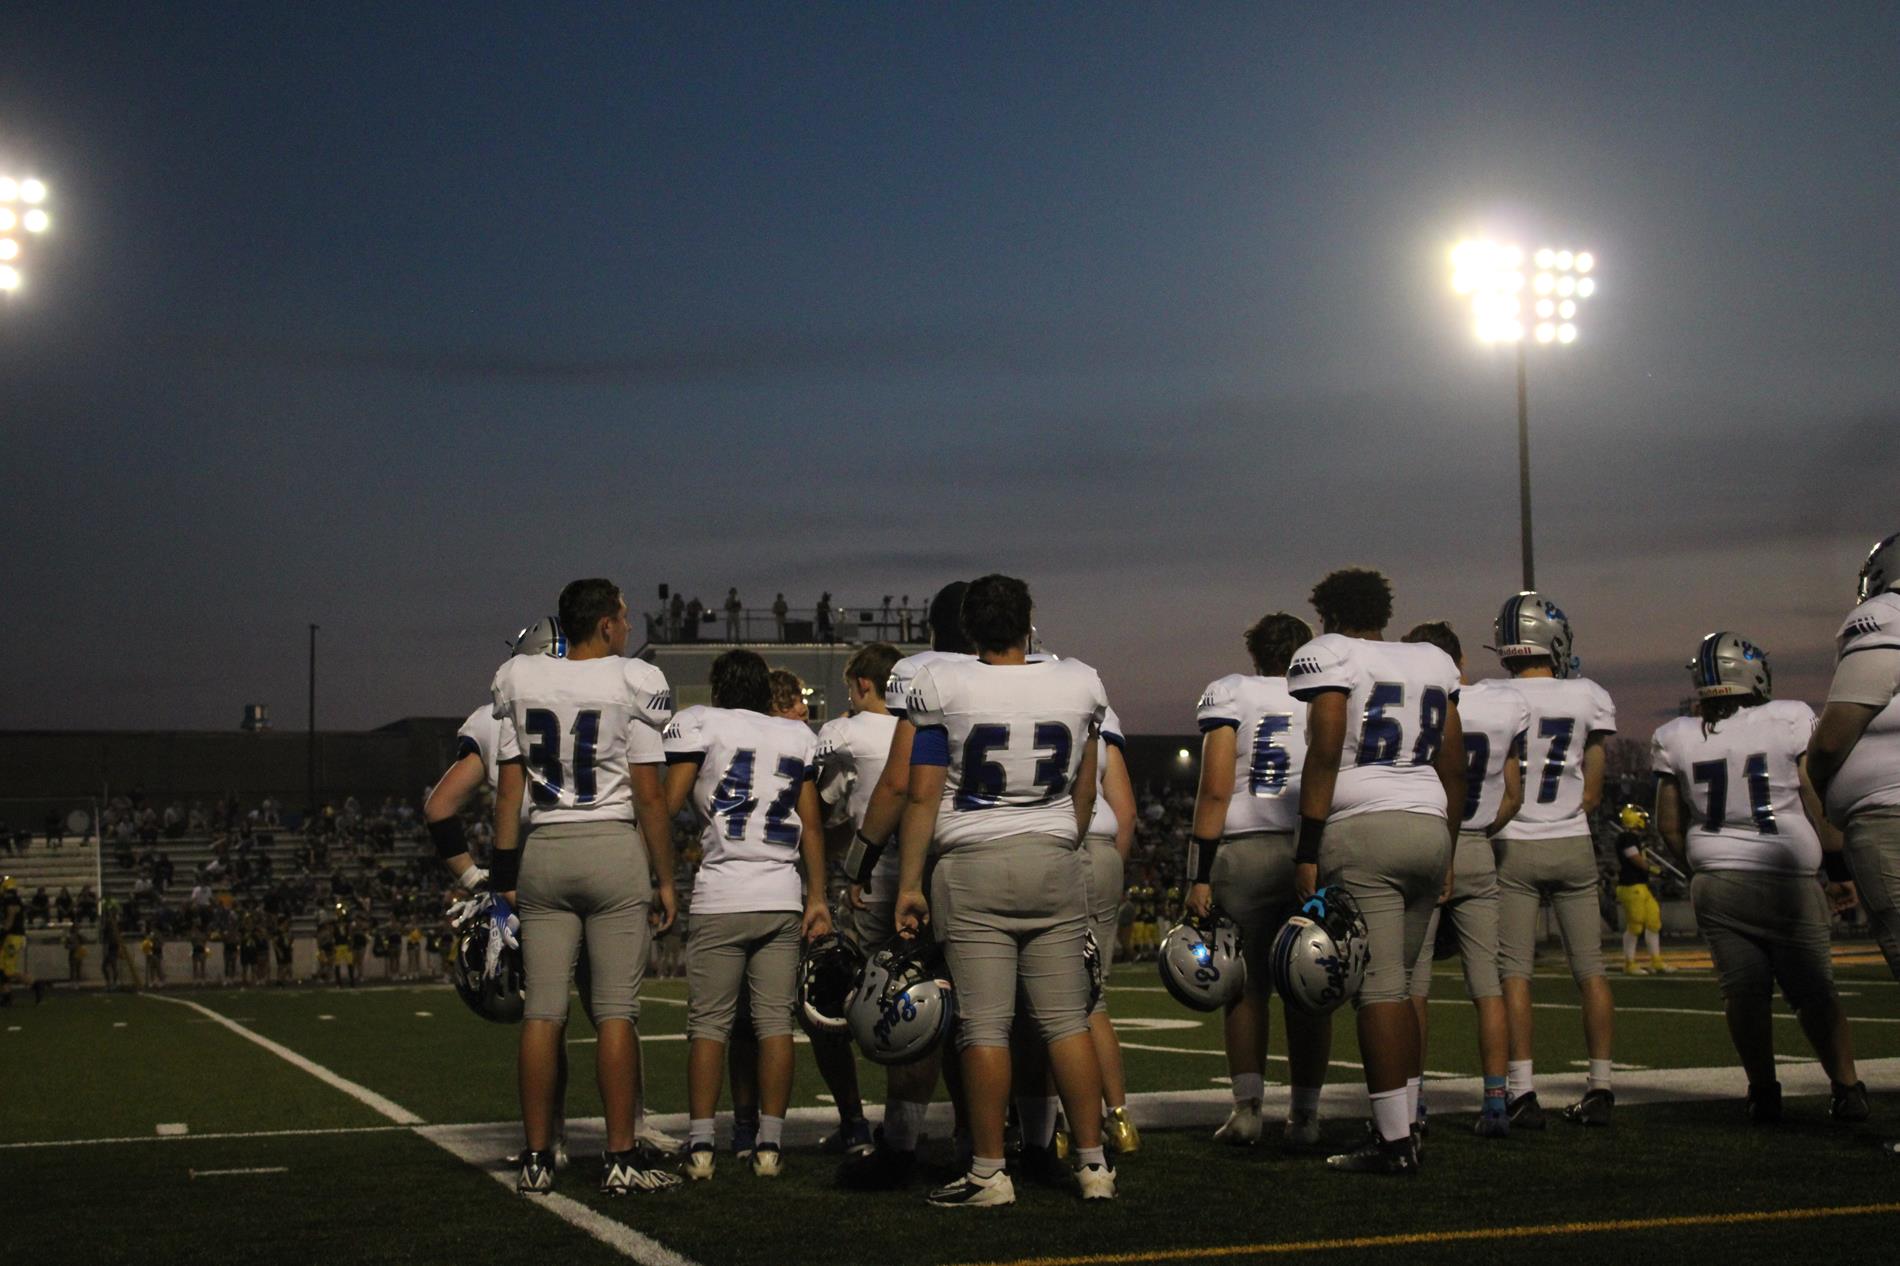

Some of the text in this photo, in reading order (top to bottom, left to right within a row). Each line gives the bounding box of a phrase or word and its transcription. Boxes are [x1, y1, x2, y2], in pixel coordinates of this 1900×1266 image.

[525, 708, 602, 805] 31
[954, 720, 1073, 812] 63
[1249, 711, 1294, 799] 6
[1355, 681, 1446, 767] 68
[711, 747, 804, 848] 42
[1692, 752, 1779, 835] 71
